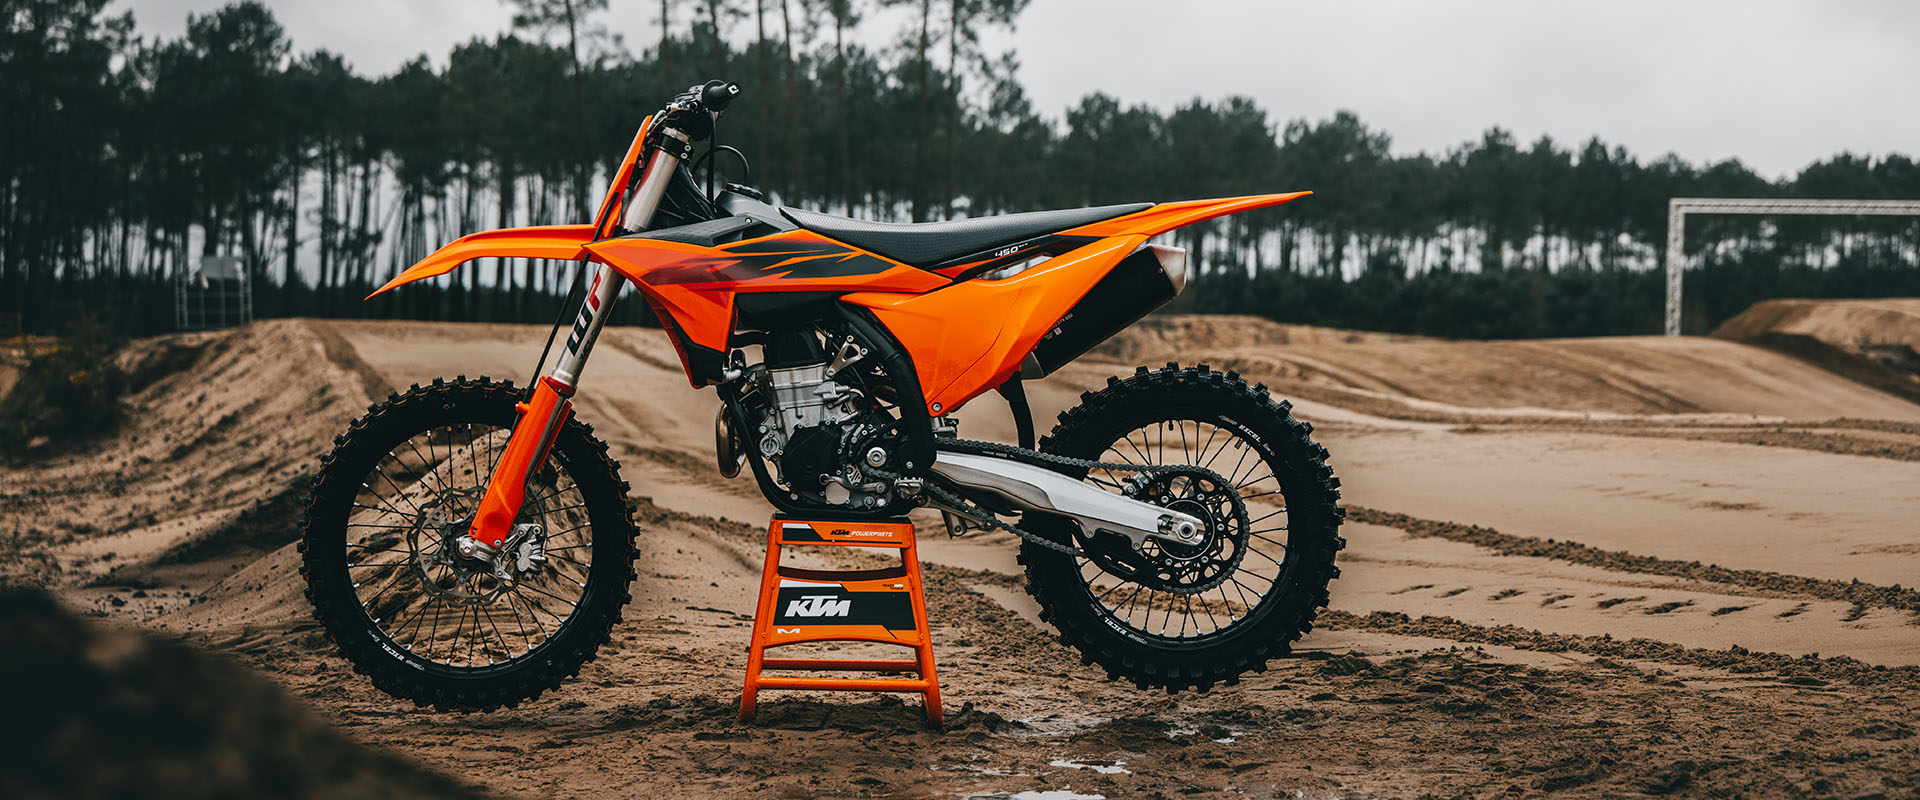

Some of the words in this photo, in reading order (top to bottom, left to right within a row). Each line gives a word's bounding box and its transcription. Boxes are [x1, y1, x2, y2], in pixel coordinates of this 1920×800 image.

[995, 246, 1018, 257] 450
[1238, 424, 1261, 443] EXCEL
[784, 595, 852, 617] KTM
[1104, 616, 1128, 636] EXCEL
[382, 642, 405, 661] EXCEL
